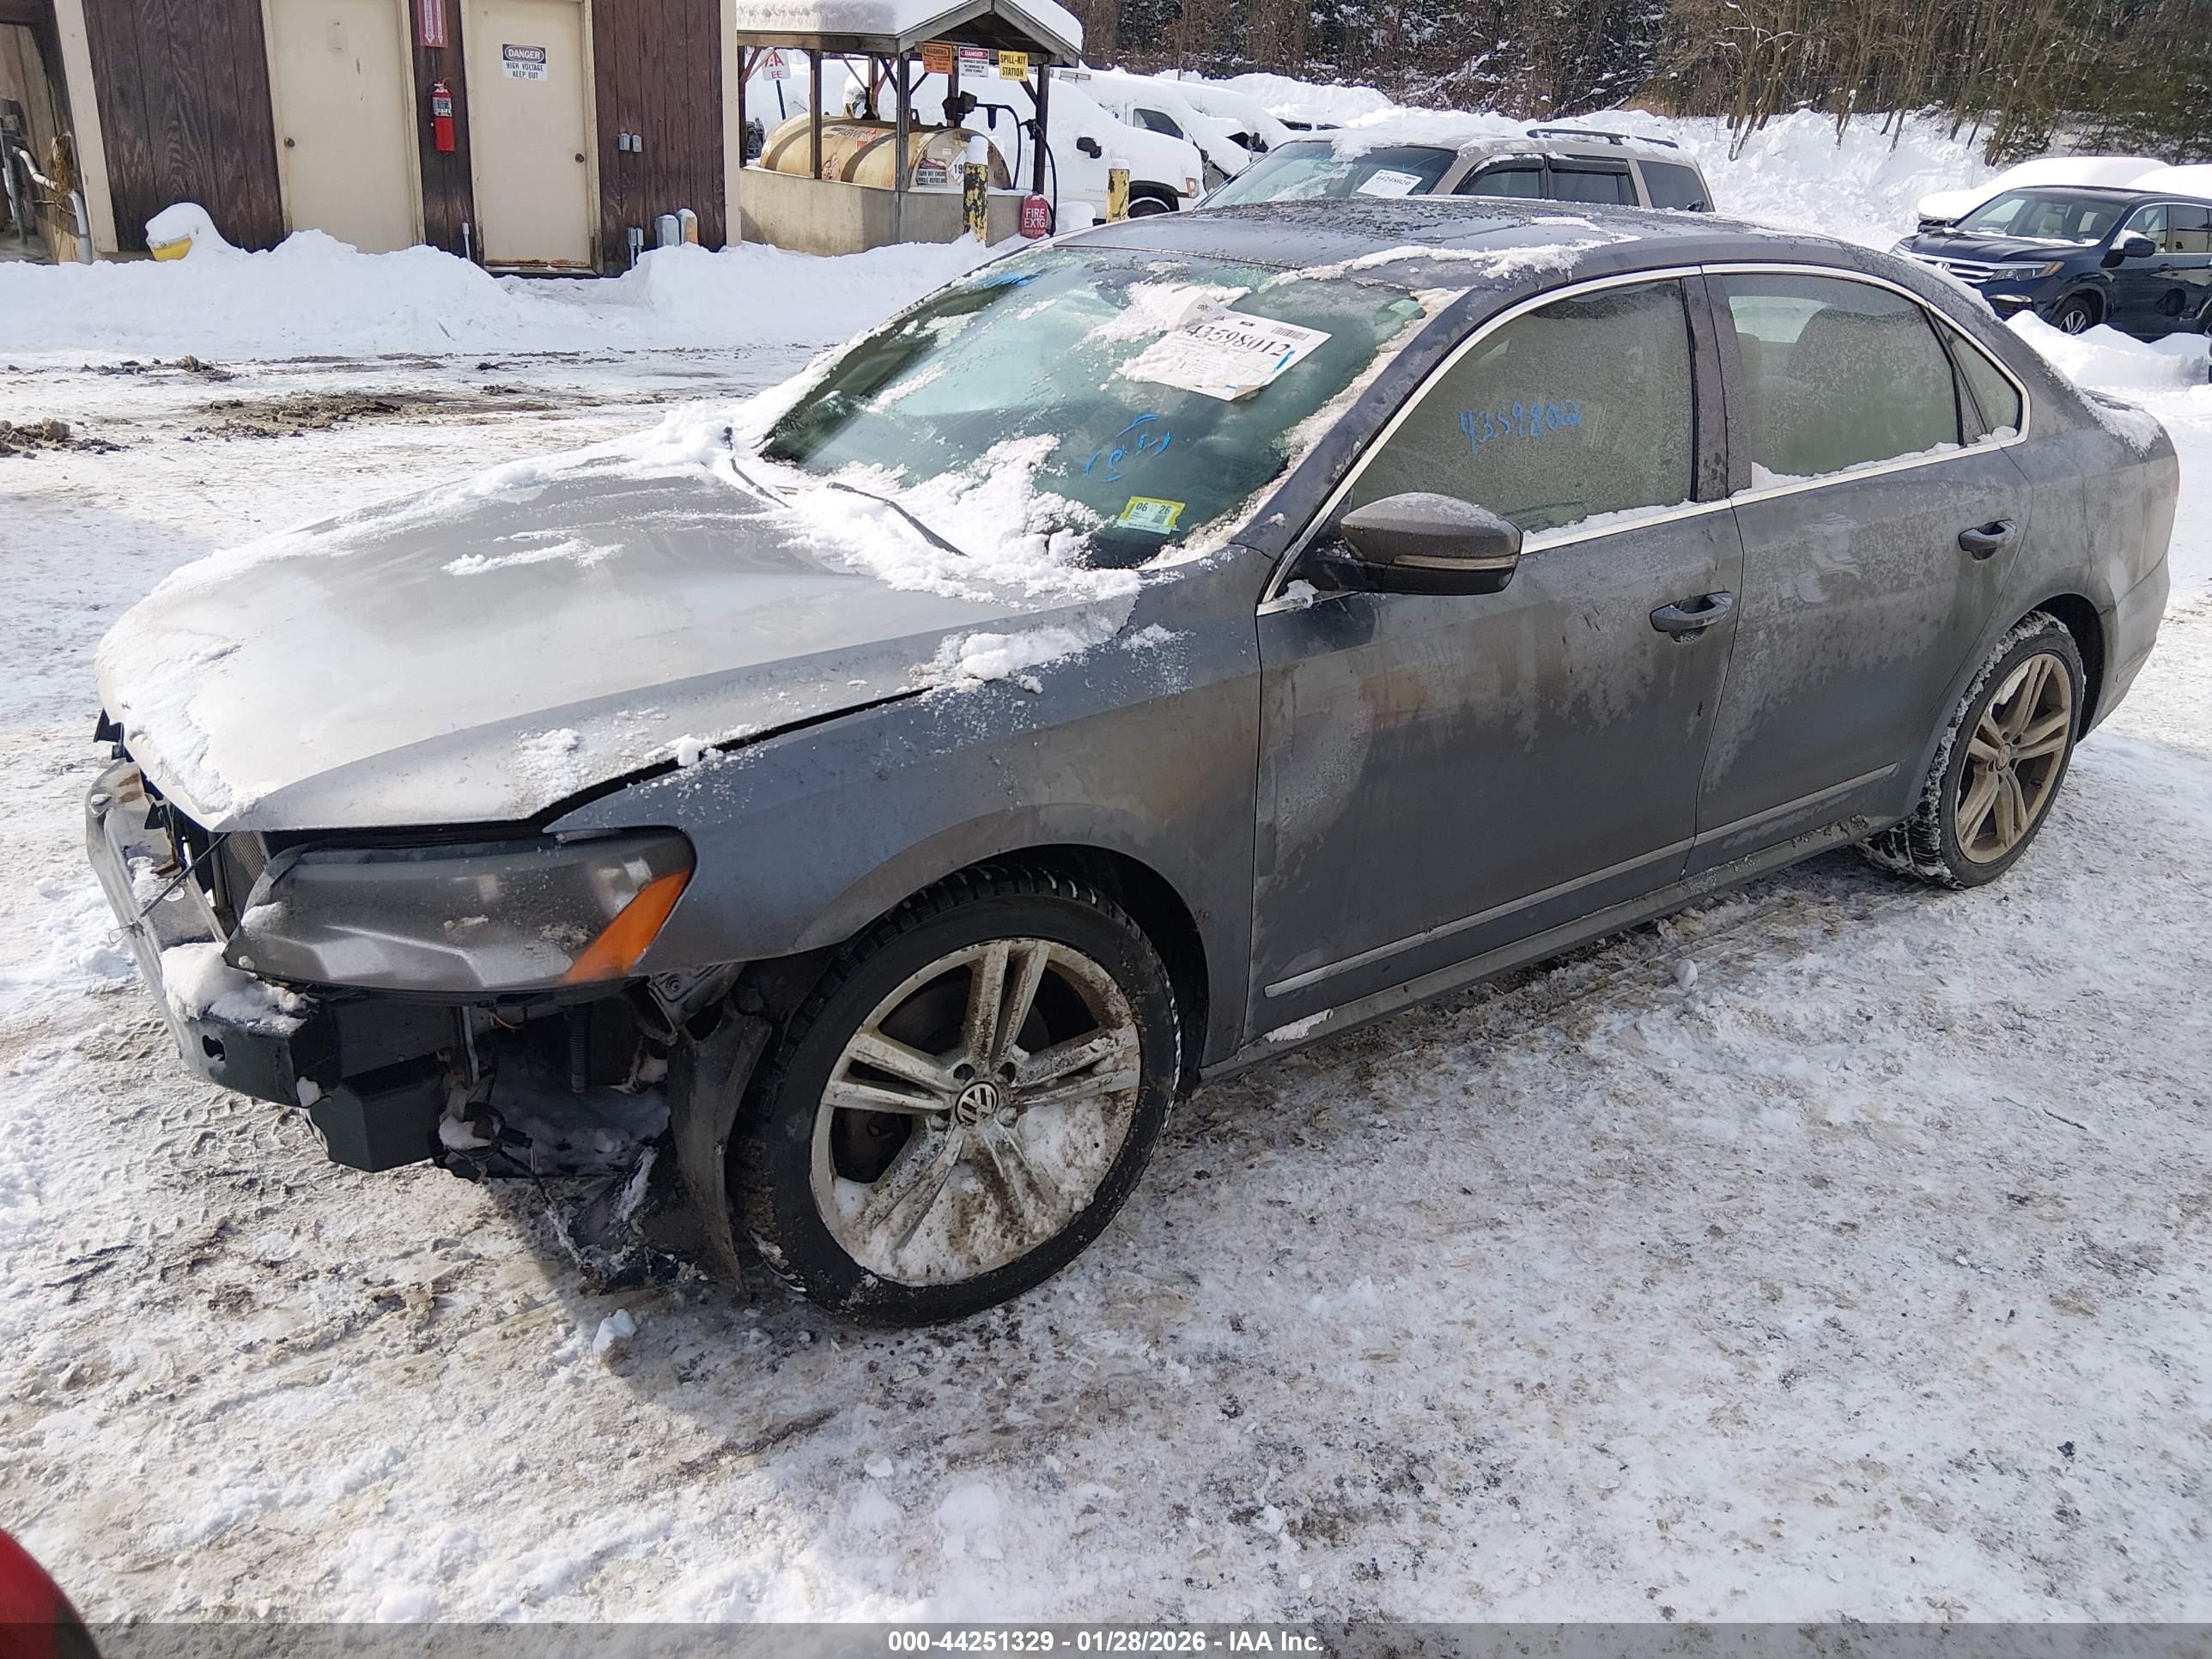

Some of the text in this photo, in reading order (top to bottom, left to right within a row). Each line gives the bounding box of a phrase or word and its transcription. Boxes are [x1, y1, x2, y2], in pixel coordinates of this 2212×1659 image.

[507, 49, 540, 59] DANGER
[1000, 54, 1026, 65] SPILL-KIT
[522, 63, 544, 71] VOLTAGE
[1002, 67, 1024, 77] STATION
[1025, 208, 1045, 218] FIRE
[1024, 218, 1045, 228] EXTG
[1187, 325, 1291, 356] 43598012
[1136, 502, 1171, 514] 06 26
